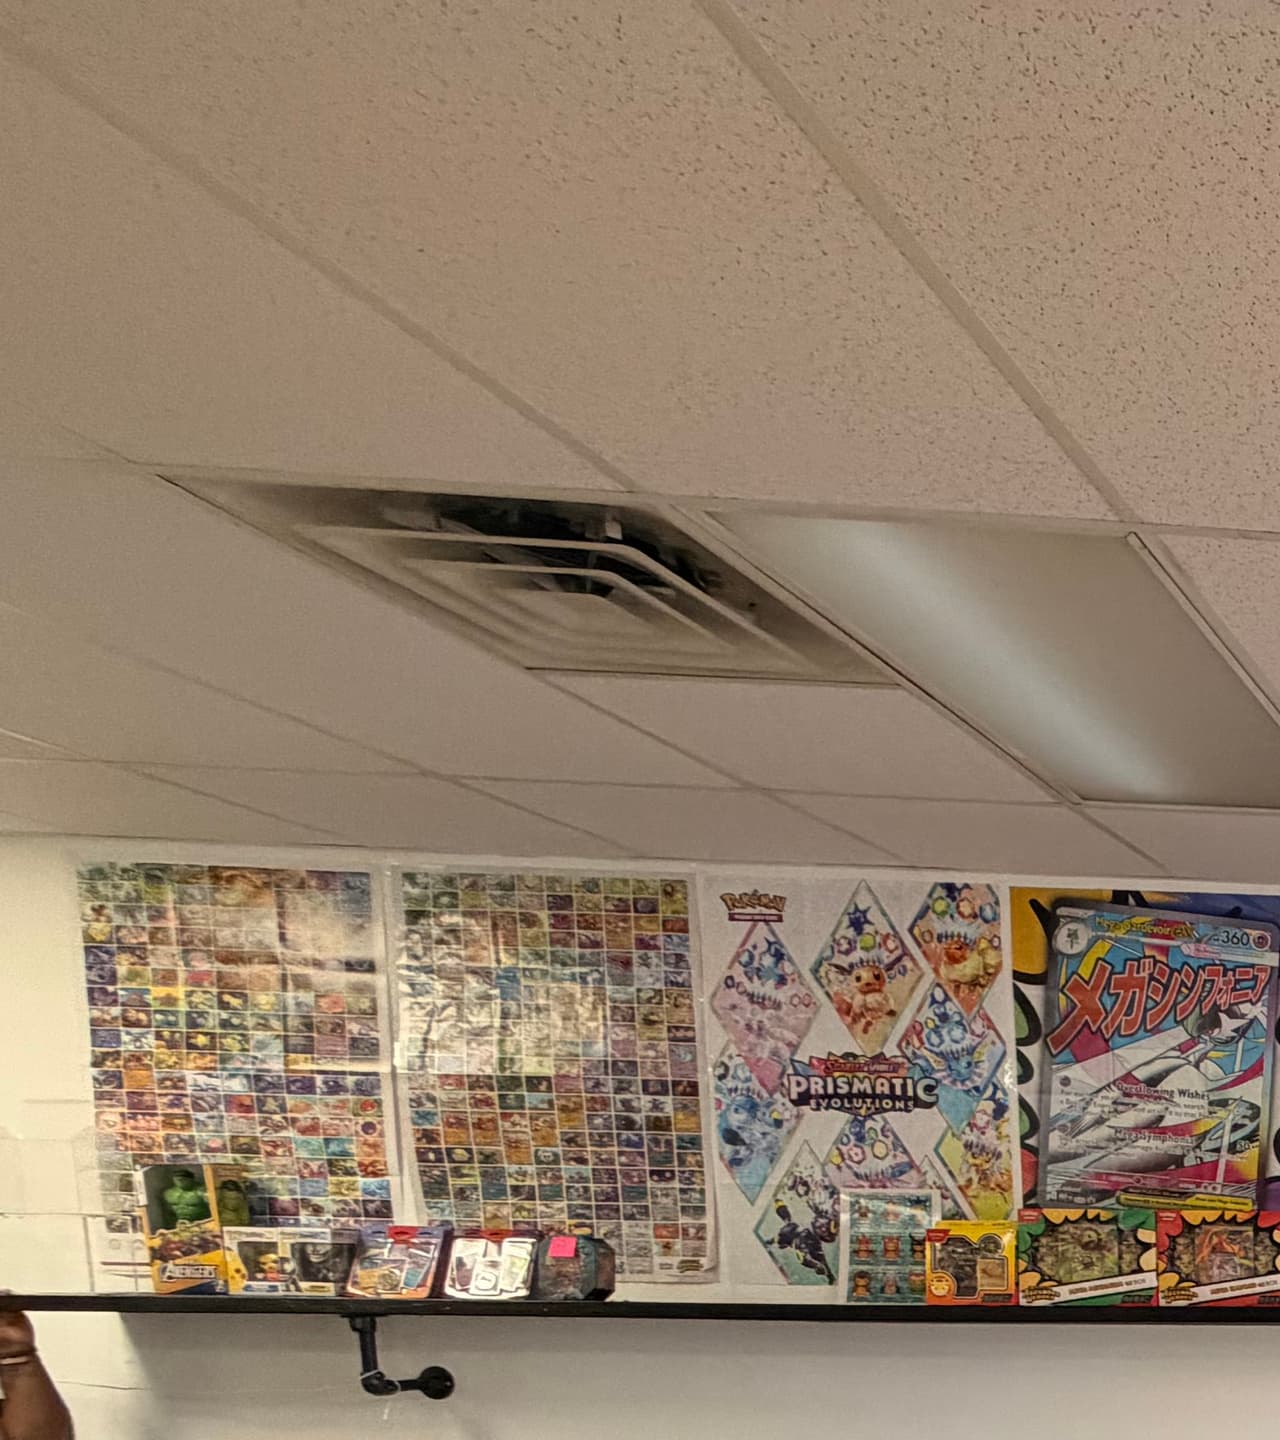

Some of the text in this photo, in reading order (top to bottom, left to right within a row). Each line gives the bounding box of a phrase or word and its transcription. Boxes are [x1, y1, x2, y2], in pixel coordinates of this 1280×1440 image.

[1221, 930, 1250, 946] 360
[1046, 958, 1271, 1055] メガシンフォニア
[788, 1076, 938, 1103] PRISMATIC
[1177, 1087, 1210, 1100] Wishes
[810, 1098, 914, 1111] EVOLUTIONS
